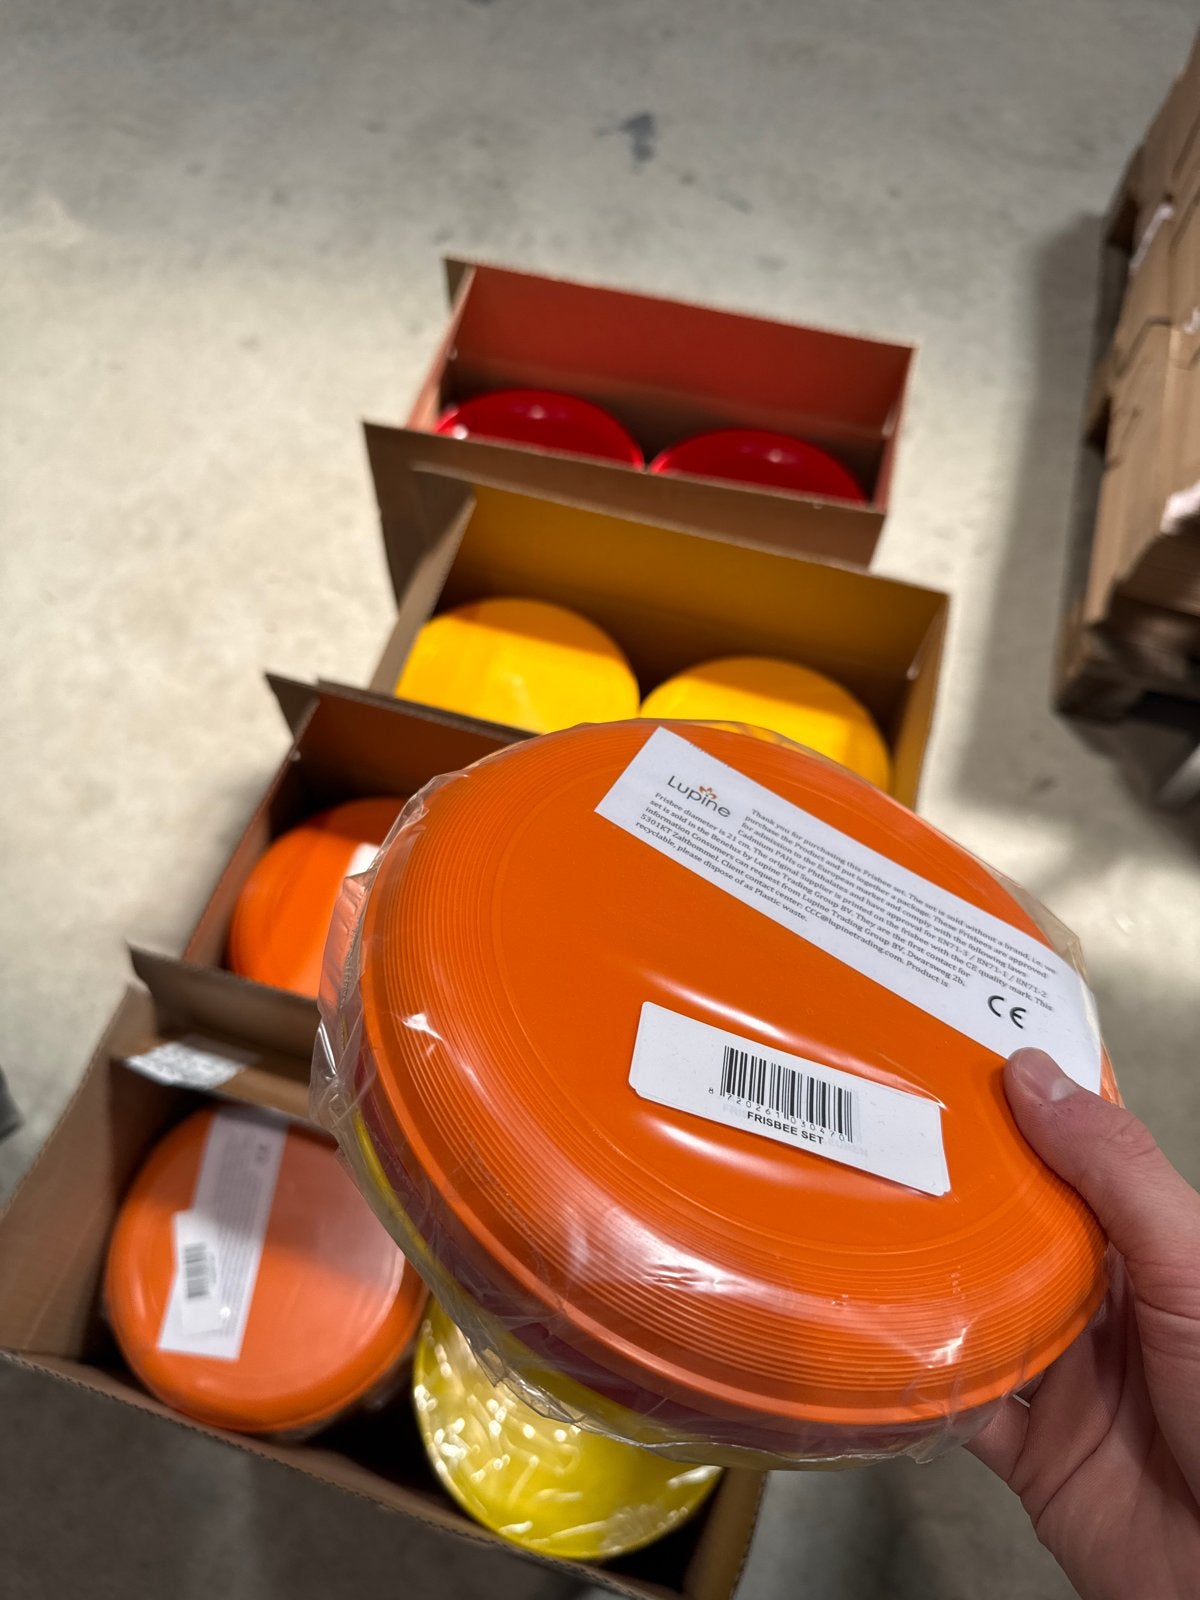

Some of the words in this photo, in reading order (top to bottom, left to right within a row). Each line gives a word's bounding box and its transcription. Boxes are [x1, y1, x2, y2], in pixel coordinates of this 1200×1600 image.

[635, 821, 676, 848] recyclable,
[676, 845, 702, 862] please
[702, 860, 733, 880] dispose
[734, 877, 744, 885] of
[754, 887, 781, 906] Plastic
[782, 903, 808, 921] waste.
[667, 775, 731, 818] Lupine
[640, 813, 672, 833] 5301KT
[720, 859, 744, 875] Client
[744, 873, 774, 892] contact
[906, 959, 940, 982] Product
[940, 978, 948, 986] is
[645, 806, 690, 835] information
[691, 832, 734, 859] Consumers
[734, 858, 749, 868] can
[749, 865, 780, 885] request
[780, 882, 801, 896] from
[801, 893, 830, 913] Lupine
[830, 909, 863, 931] Trading
[863, 927, 890, 945] Group
[906, 950, 951, 979] Dwarsweg
[649, 799, 662, 809] set
[670, 811, 687, 823] sold
[687, 820, 696, 828] in
[696, 825, 710, 835] the
[710, 833, 741, 854] Benelux
[741, 851, 752, 860] by
[753, 857, 780, 876] Lupine
[781, 872, 813, 894] Trading
[813, 890, 839, 908] Group
[854, 912, 876, 928] They
[876, 925, 890, 935] are
[892, 932, 906, 943] the
[907, 940, 924, 953] first
[925, 950, 957, 970] contact
[957, 967, 970, 977] for
[655, 792, 683, 810] Frisbee
[683, 809, 718, 830] diameter
[726, 832, 736, 841] 21
[752, 846, 768, 858] The
[768, 856, 799, 876] original
[799, 873, 833, 895] Supplier
[834, 891, 841, 899] is
[841, 896, 872, 916] printed
[873, 913, 884, 922] on
[885, 919, 899, 929] the
[900, 927, 929, 945] frisbee
[930, 943, 949, 956] with
[950, 953, 964, 963] the
[965, 961, 977, 971] CE
[977, 968, 1008, 987] quality
[1033, 996, 1053, 1010] This
[737, 829, 774, 852] Cadmium
[807, 867, 848, 893] Phthalates
[849, 891, 865, 901] and
[865, 898, 885, 912] have
[885, 910, 922, 932] approval
[923, 929, 936, 938] for
[741, 822, 753, 831] for
[753, 829, 792, 853] admission
[793, 850, 802, 858] to
[803, 856, 816, 865] the
[816, 863, 855, 887] European
[855, 884, 884, 902] market
[885, 900, 901, 911] and
[901, 909, 932, 928] comply
[932, 925, 952, 938] with
[953, 935, 967, 945] the
[967, 942, 1006, 967] following
[1007, 963, 1027, 976] laws
[744, 815, 779, 837] purchase
[780, 834, 793, 844] the
[794, 841, 824, 861] Product
[825, 859, 840, 870] and
[840, 867, 855, 878] put
[855, 875, 890, 896] together
[932, 914, 957, 931] These
[958, 928, 992, 949] Frisbees
[993, 948, 1007, 957] are
[1008, 955, 1047, 978] approved
[747, 1111, 798, 1136] FRISBEE
[801, 1130, 824, 1144] SET
